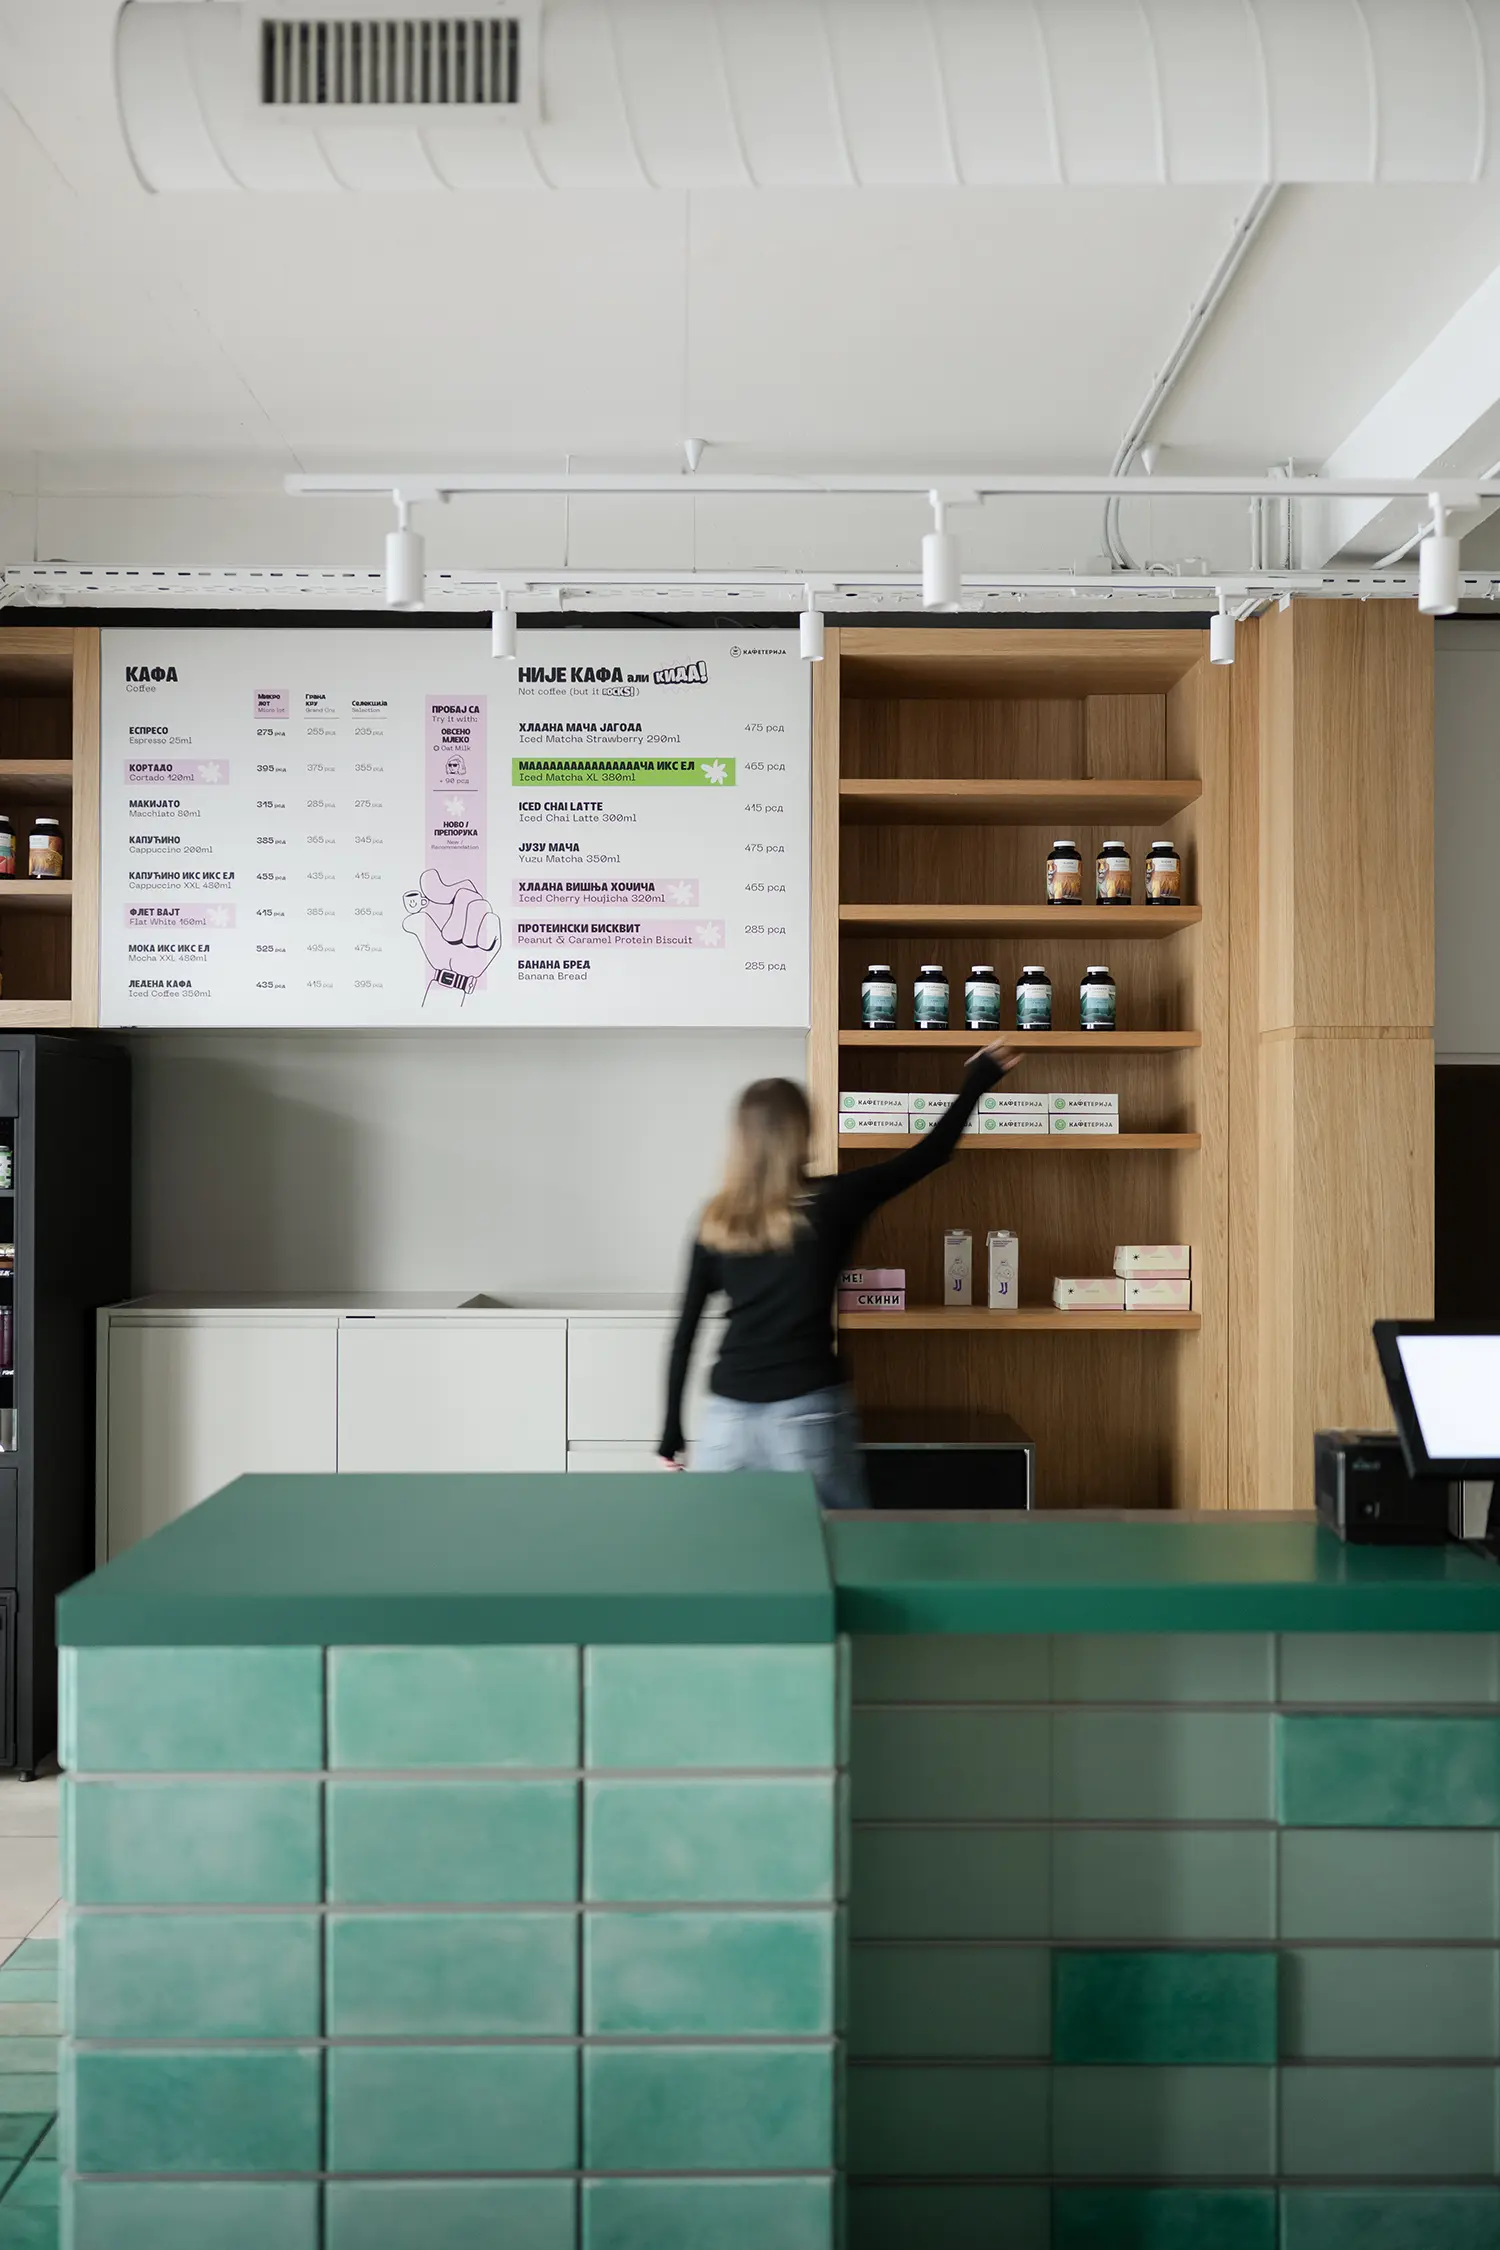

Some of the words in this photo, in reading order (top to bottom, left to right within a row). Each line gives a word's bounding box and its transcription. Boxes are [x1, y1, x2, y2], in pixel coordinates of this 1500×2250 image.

[125, 666, 178, 682] КАФА
[518, 667, 567, 683] НИЈЕ
[570, 667, 624, 683] КАФА
[627, 674, 650, 683] али
[653, 660, 708, 684] КИДА!
[125, 684, 156, 693] Coffee
[518, 687, 535, 696] Not
[537, 687, 567, 696] coffee
[569, 687, 589, 697] (but
[592, 687, 600, 696] it
[432, 705, 467, 714] ПРОБАЈ
[468, 705, 480, 714] СА
[432, 715, 445, 724] Try
[447, 715, 454, 723] it
[129, 726, 169, 735] ЕСПРЕСО
[519, 723, 564, 732] ХЛАДНА
[566, 723, 597, 732] МАЧА
[599, 722, 642, 732] ЈАГОДА
[744, 723, 764, 732] 475
[766, 725, 785, 733] рсд
[256, 728, 274, 736] 275
[129, 736, 167, 745] Espresso
[168, 736, 192, 745] 25ml
[442, 736, 470, 744] МЛЕКО
[519, 734, 543, 743] Iced
[545, 734, 584, 743] Matcha
[586, 734, 644, 745] Strawberry
[646, 734, 681, 743] 290ml
[129, 763, 173, 772] КОРТАДО
[256, 764, 275, 772] 395
[656, 761, 679, 771] ИКС
[680, 761, 695, 771] ЕЛ
[744, 761, 765, 771] 465
[767, 763, 786, 772] рсд
[129, 773, 165, 782] Cortado
[167, 773, 195, 782] 120ml
[519, 773, 543, 782] Iced
[545, 773, 584, 782] Matcha
[586, 773, 599, 782] XL
[601, 772, 636, 782] 380ml
[129, 799, 181, 808] МАКИЈАТО
[256, 800, 274, 808] 315
[518, 801, 542, 811] ICED
[543, 801, 568, 811] CHAI
[570, 801, 603, 811] LATTE
[744, 803, 763, 813] 415
[765, 805, 784, 814] рсд
[128, 809, 176, 818] Macchiato
[177, 809, 201, 818] 80ml
[519, 813, 543, 823] Iced
[545, 813, 570, 822] Chai
[572, 814, 599, 823] Latte
[602, 813, 637, 823] 300ml
[129, 835, 181, 844] КАПУЋИНО
[256, 836, 274, 845] 385
[128, 845, 182, 855] Cappuccino
[183, 845, 213, 854] 200ml
[518, 842, 546, 852] ЈУЗУ
[548, 842, 580, 852] МАЧА
[744, 843, 764, 853] 475
[766, 845, 785, 854] рсд
[518, 854, 543, 863] Yuzu
[545, 854, 584, 863] Matcha
[586, 854, 621, 863] 350ml
[128, 871, 181, 880] КАПУЋИНО
[182, 871, 201, 880] ИКС
[202, 871, 221, 880] ИКС
[222, 871, 235, 880] ЕЛ
[256, 873, 274, 881] 455
[128, 881, 182, 891] Cappuccino
[183, 881, 200, 889] XXL
[202, 881, 232, 890] 480ml
[518, 882, 564, 892] ХЛАДНА
[565, 882, 608, 892] ВИШЊА
[744, 882, 765, 892] 465
[767, 884, 786, 893] рсд
[519, 894, 543, 903] Iced
[545, 894, 581, 905] Cherry
[583, 894, 629, 904] Houjicha
[631, 893, 666, 903] 320ml
[129, 908, 155, 916] ФЛЕТ
[156, 908, 180, 916] ВАЈТ
[256, 909, 273, 917] 415
[129, 917, 148, 926] Flat
[149, 918, 177, 926] White
[518, 923, 589, 933] ПРОТЕИНСКИ
[591, 923, 641, 933] БИСКВИТ
[744, 924, 765, 934] 285
[767, 926, 786, 935] рсд
[518, 935, 553, 944] Peanut
[568, 935, 612, 944] Caramel
[614, 935, 653, 945] Protein
[655, 935, 693, 945] Biscuit
[128, 944, 156, 953] МОКА
[157, 944, 176, 953] ИКС
[177, 944, 196, 953] ИКС
[198, 944, 210, 953] ЕЛ
[256, 945, 274, 953] 525
[128, 954, 157, 962] Mocha
[159, 954, 176, 962] XXL
[178, 954, 207, 962] 480ml
[518, 960, 561, 969] БАНАНА
[563, 960, 591, 970] БРЕД
[744, 961, 765, 970] 285
[767, 963, 787, 972] рсд
[518, 971, 555, 981] Banana
[557, 971, 588, 981] Bread
[128, 979, 165, 988] ЛЕДЕНА
[166, 980, 192, 988] КАФА
[256, 981, 274, 989] 435
[128, 989, 149, 998] Iced
[150, 989, 180, 998] Coffee
[181, 989, 211, 998] 350ml
[858, 1295, 900, 1305] СКИНИ
